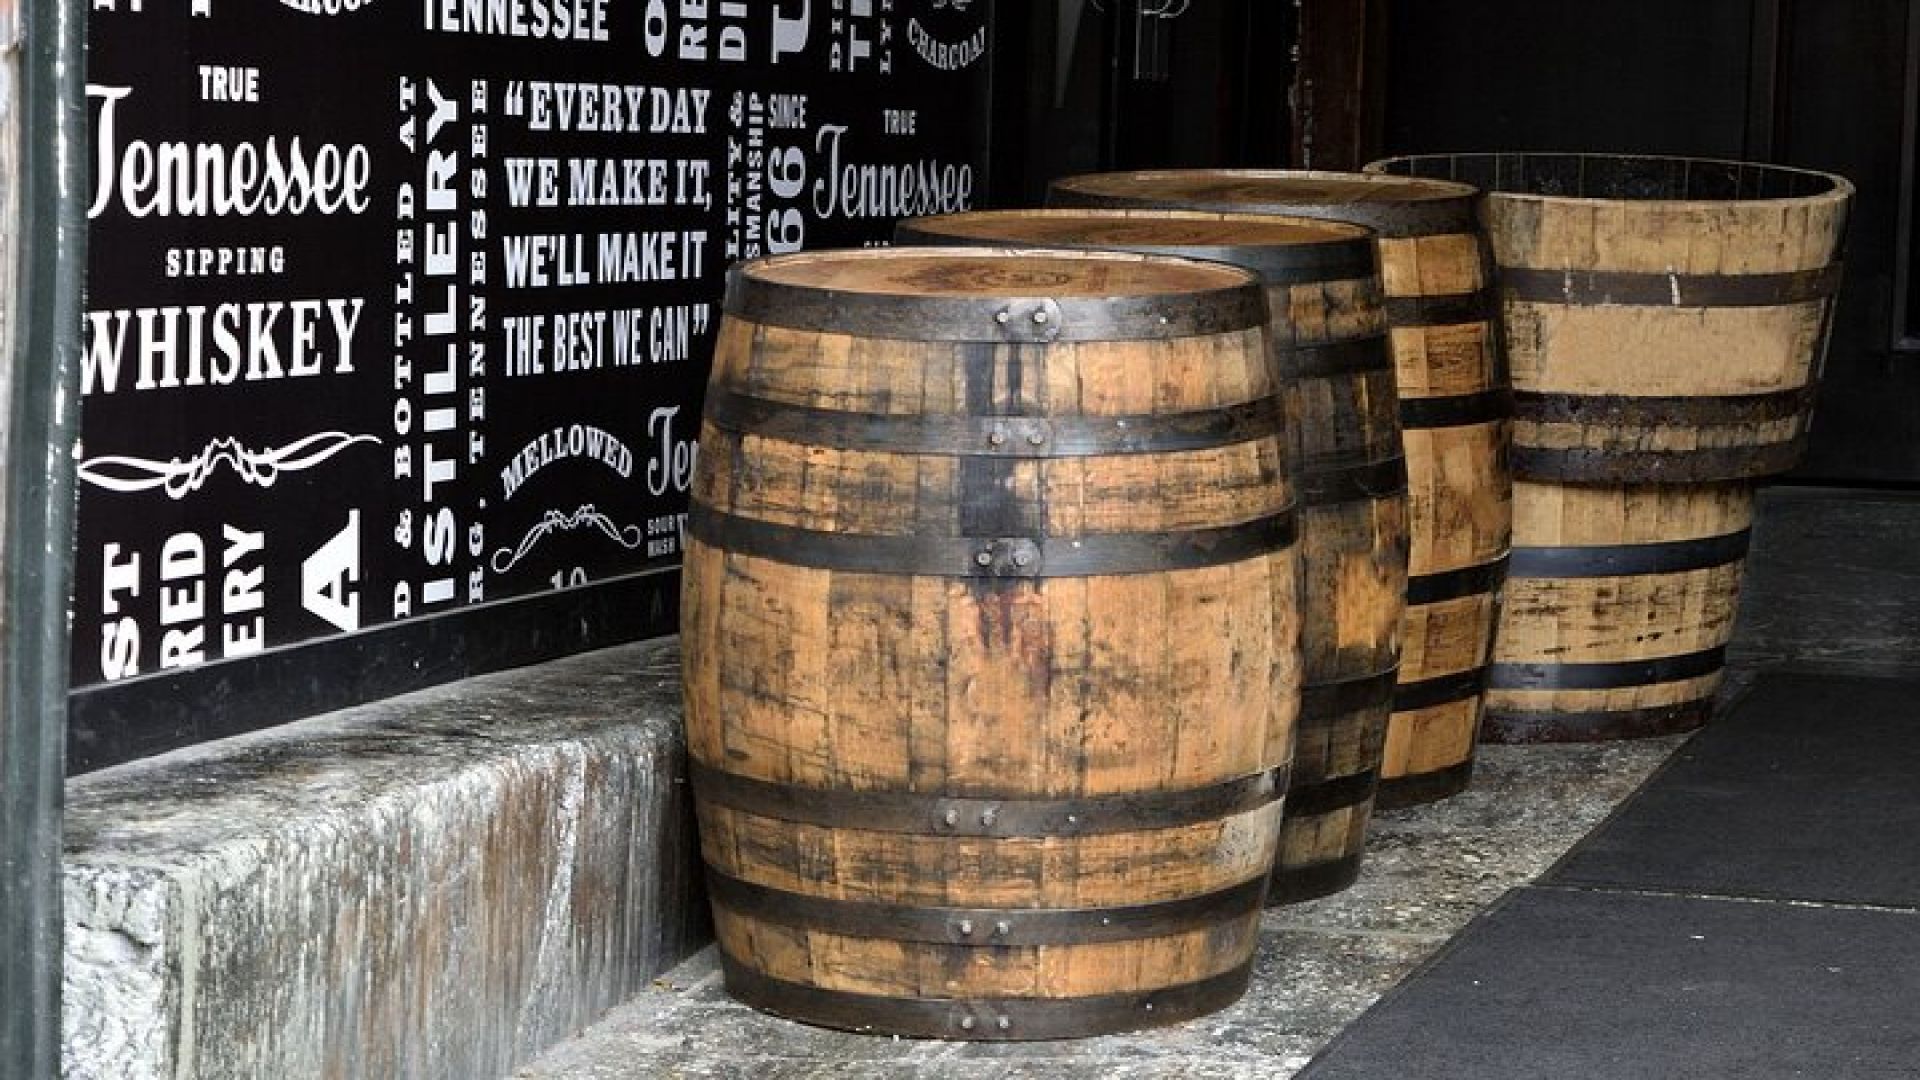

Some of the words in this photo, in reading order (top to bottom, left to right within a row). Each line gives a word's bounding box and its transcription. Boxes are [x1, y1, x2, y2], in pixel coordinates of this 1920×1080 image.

[425, 0, 609, 41] TENNESSEE
[199, 65, 260, 102] TRUE
[399, 76, 416, 153] AT
[650, 88, 711, 134] DAY
[729, 90, 744, 128] &
[767, 93, 807, 128] SINCE
[883, 109, 916, 135] TRUE
[85, 85, 371, 218] Tennessee
[504, 158, 559, 207] WE
[567, 158, 668, 206] MAKE
[674, 159, 713, 212] IT,
[745, 92, 763, 259] SMANSHIP
[812, 123, 972, 219] Tennessee
[725, 135, 742, 259] LITY
[165, 246, 286, 278] SIPPING
[468, 80, 488, 465] TENNESSEE
[503, 234, 590, 289] WE'LL
[597, 231, 676, 284] MAKE
[682, 231, 708, 280] IT
[80, 298, 364, 396] WHISKEY
[394, 182, 414, 480] BOTTLED
[424, 77, 457, 604] ISTILLERY
[503, 315, 545, 377] THE
[554, 311, 606, 372] BEST
[612, 307, 643, 367] WE
[501, 424, 633, 500] MELLOWED
[394, 509, 412, 549] &
[160, 531, 206, 670] RED
[222, 523, 265, 658] ERY
[302, 508, 361, 633] A
[103, 542, 140, 682] ST
